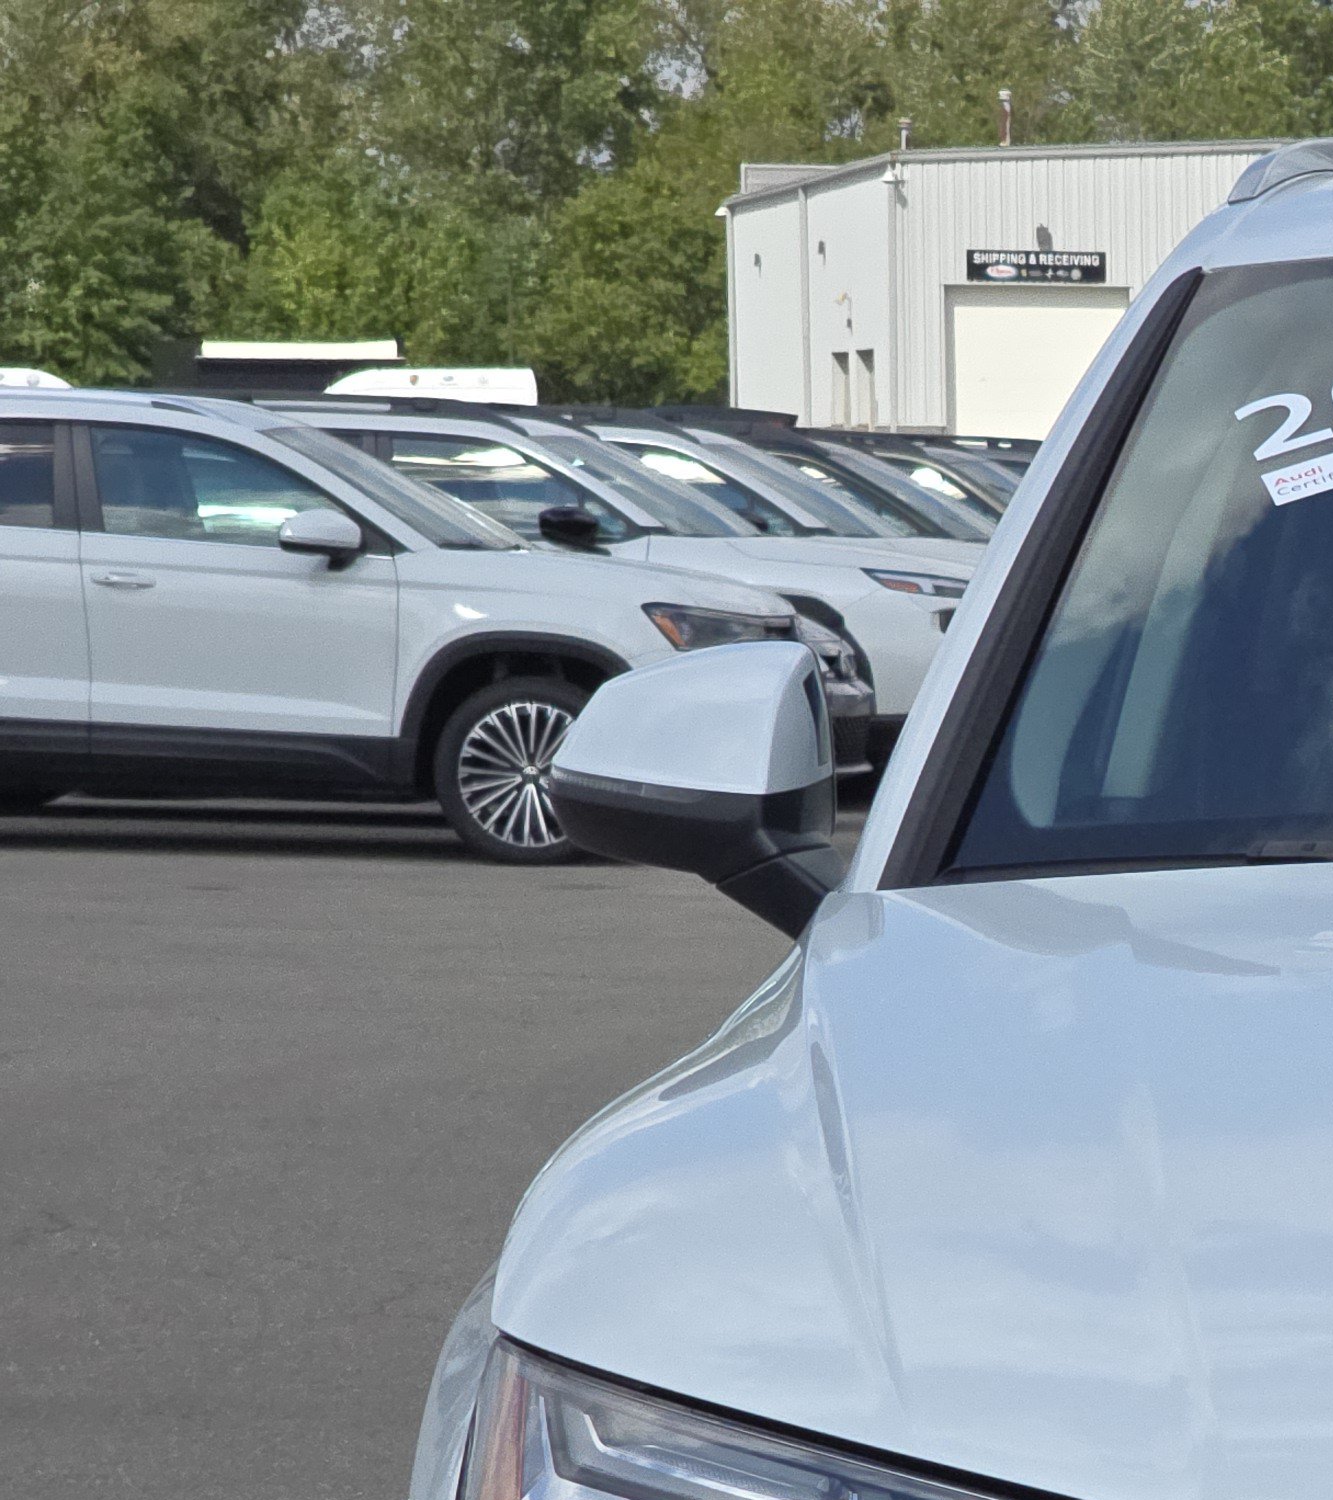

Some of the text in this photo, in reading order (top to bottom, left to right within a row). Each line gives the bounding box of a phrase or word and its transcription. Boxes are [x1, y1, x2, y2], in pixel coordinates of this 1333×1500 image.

[973, 252, 1026, 265] SHIPPING
[1039, 253, 1100, 266] RECEIVING
[1273, 465, 1324, 487] Audi
